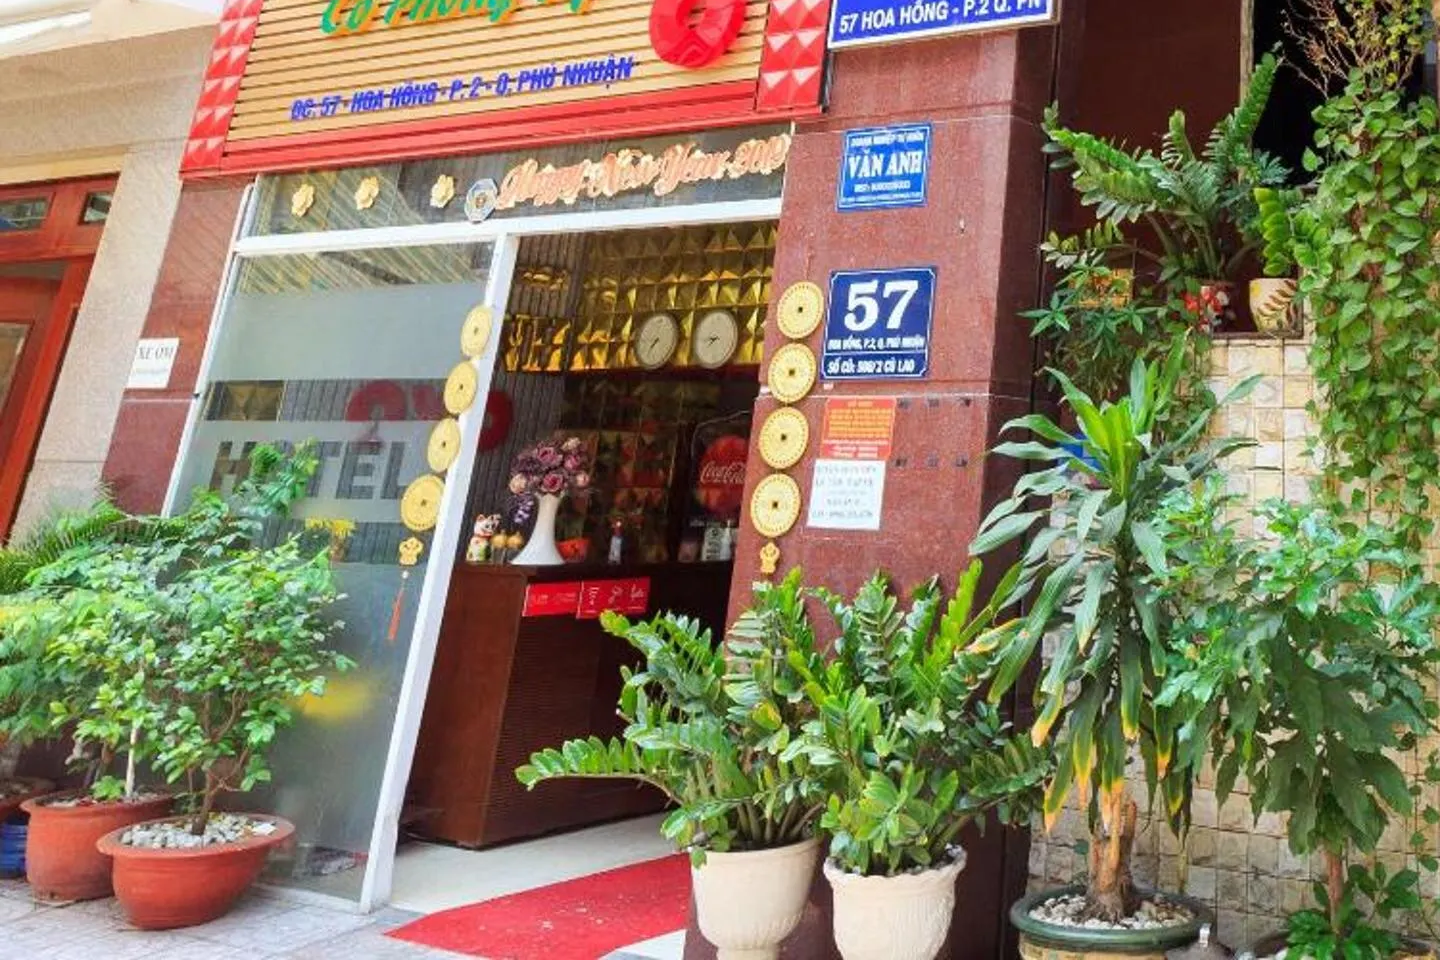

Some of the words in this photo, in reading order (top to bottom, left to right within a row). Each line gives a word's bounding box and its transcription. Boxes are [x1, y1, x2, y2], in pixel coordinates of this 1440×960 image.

[839, 13, 859, 34] 57
[861, 7, 896, 32] HOA
[320, 94, 342, 117] 57
[350, 89, 387, 114] HOA
[562, 53, 634, 89] NHUẬN
[848, 147, 885, 178] VĂN
[885, 150, 924, 176] ANH
[844, 280, 919, 331] 57
